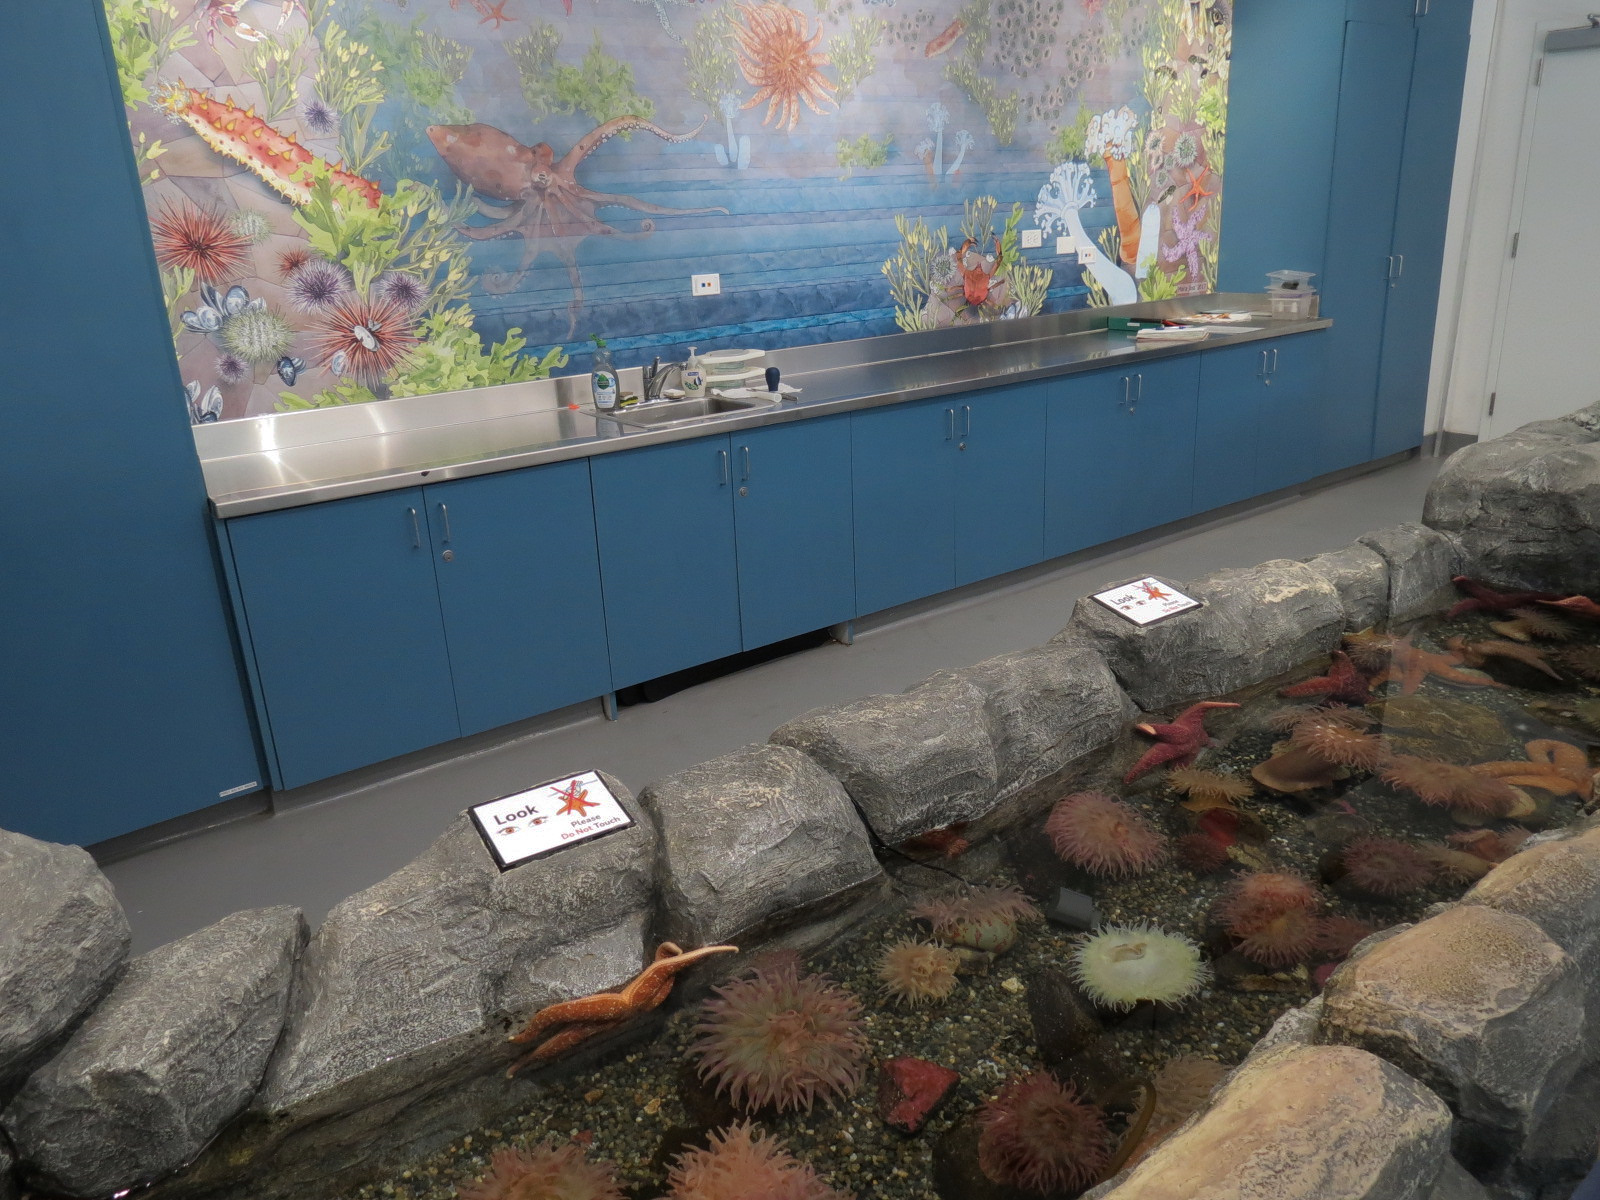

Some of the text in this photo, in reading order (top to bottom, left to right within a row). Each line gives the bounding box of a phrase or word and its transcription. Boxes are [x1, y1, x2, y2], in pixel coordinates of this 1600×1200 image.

[1111, 595, 1136, 605] Look
[494, 804, 539, 826] Look
[570, 814, 601, 828] Please
[561, 816, 621, 840] Do Not Touch
